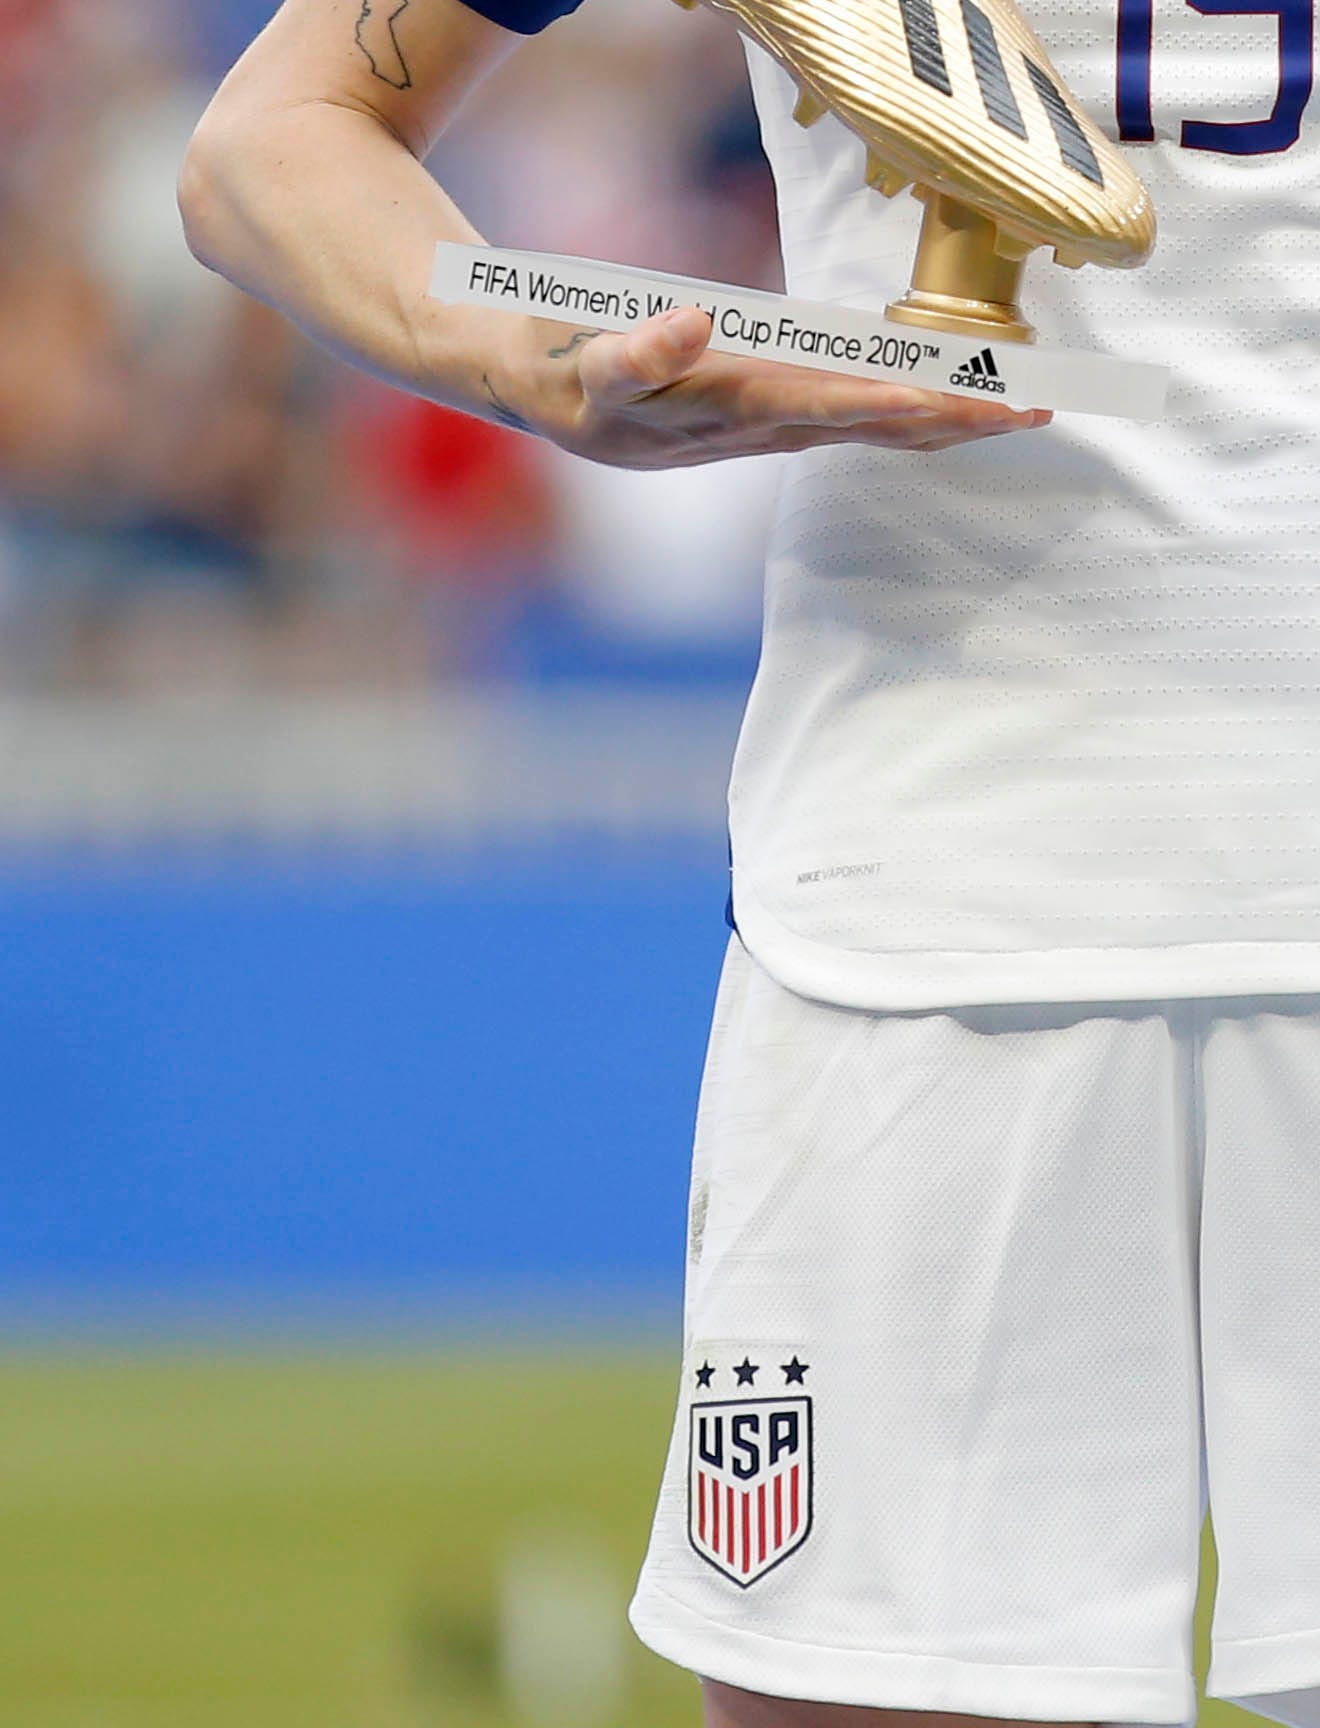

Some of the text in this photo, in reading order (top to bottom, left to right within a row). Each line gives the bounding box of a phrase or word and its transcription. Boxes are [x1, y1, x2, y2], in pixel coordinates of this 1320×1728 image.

[469, 261, 519, 298] FIFA
[528, 272, 639, 320] Women's
[721, 308, 772, 350] Cup
[776, 319, 862, 361] France
[949, 372, 1005, 394] adidas
[699, 1411, 799, 1480] USA
